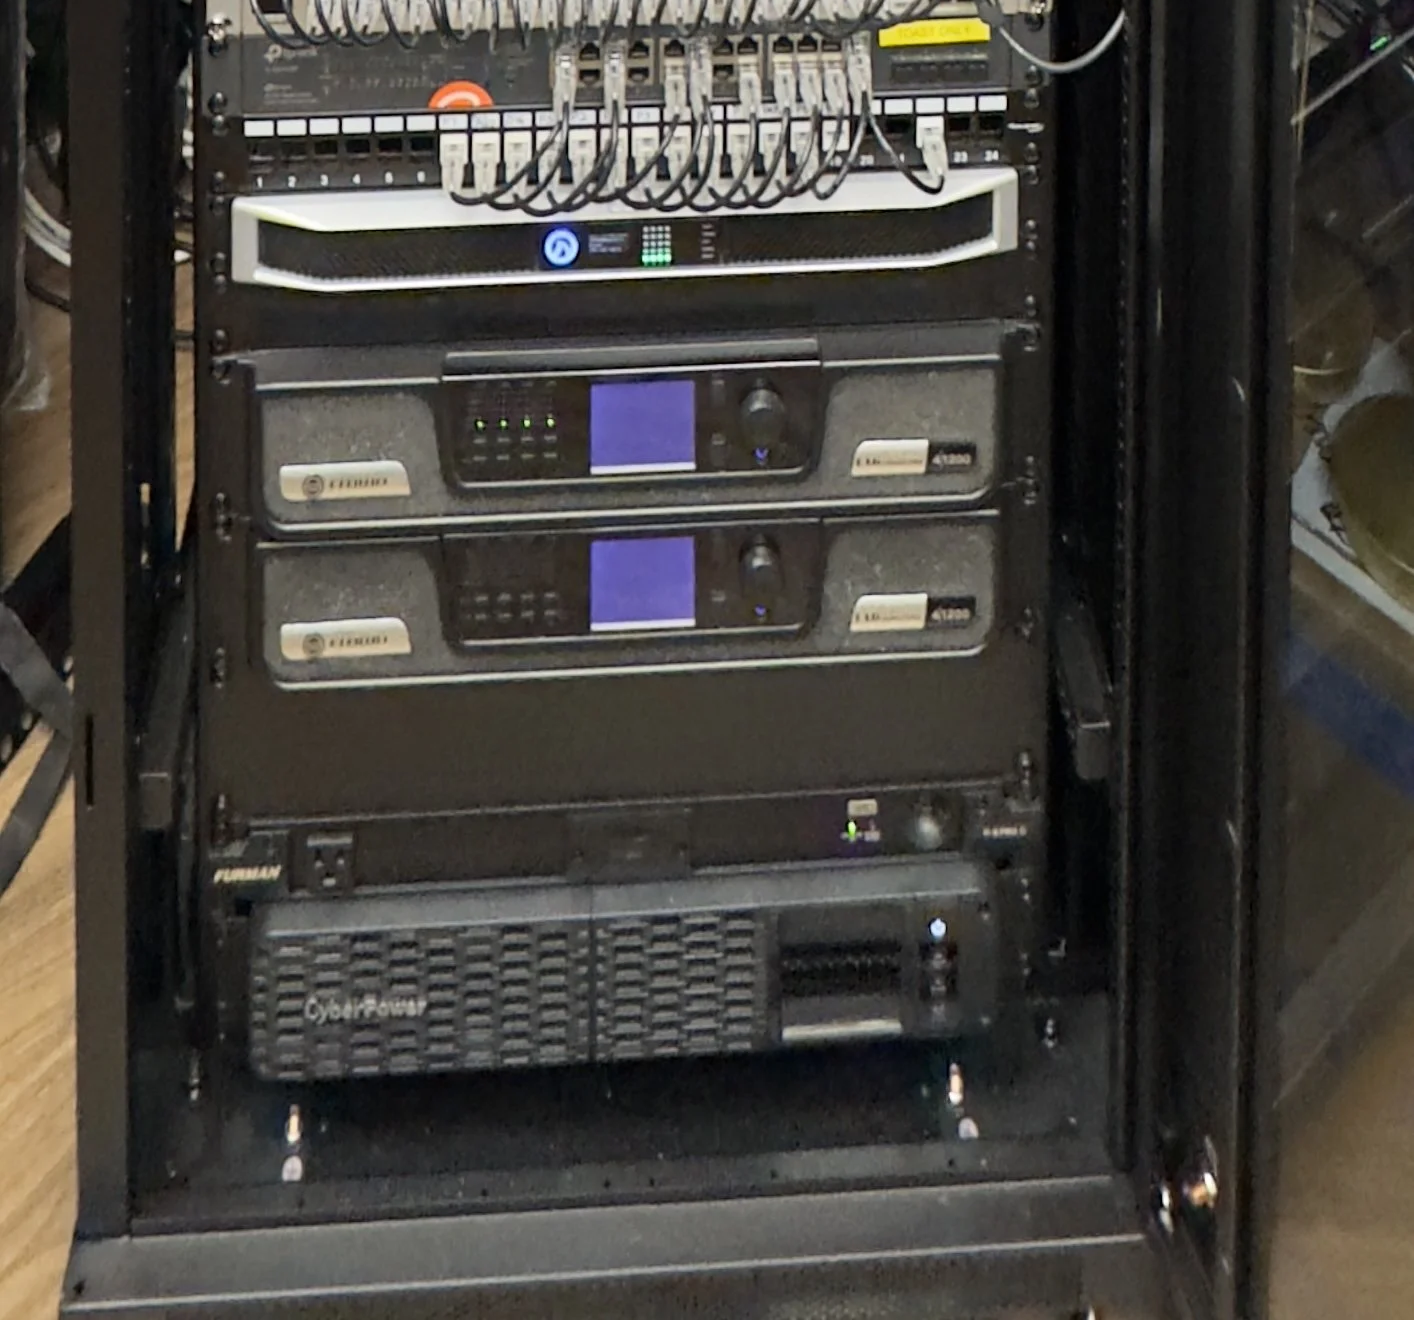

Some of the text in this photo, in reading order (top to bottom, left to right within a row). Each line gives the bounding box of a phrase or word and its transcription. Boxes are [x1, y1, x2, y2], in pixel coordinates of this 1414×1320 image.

[257, 176, 263, 188] 1
[288, 176, 296, 188] 2
[320, 174, 329, 186] 3
[352, 173, 361, 184] 4
[213, 864, 282, 884] FURMAN
[304, 994, 428, 1026] CyberPower
